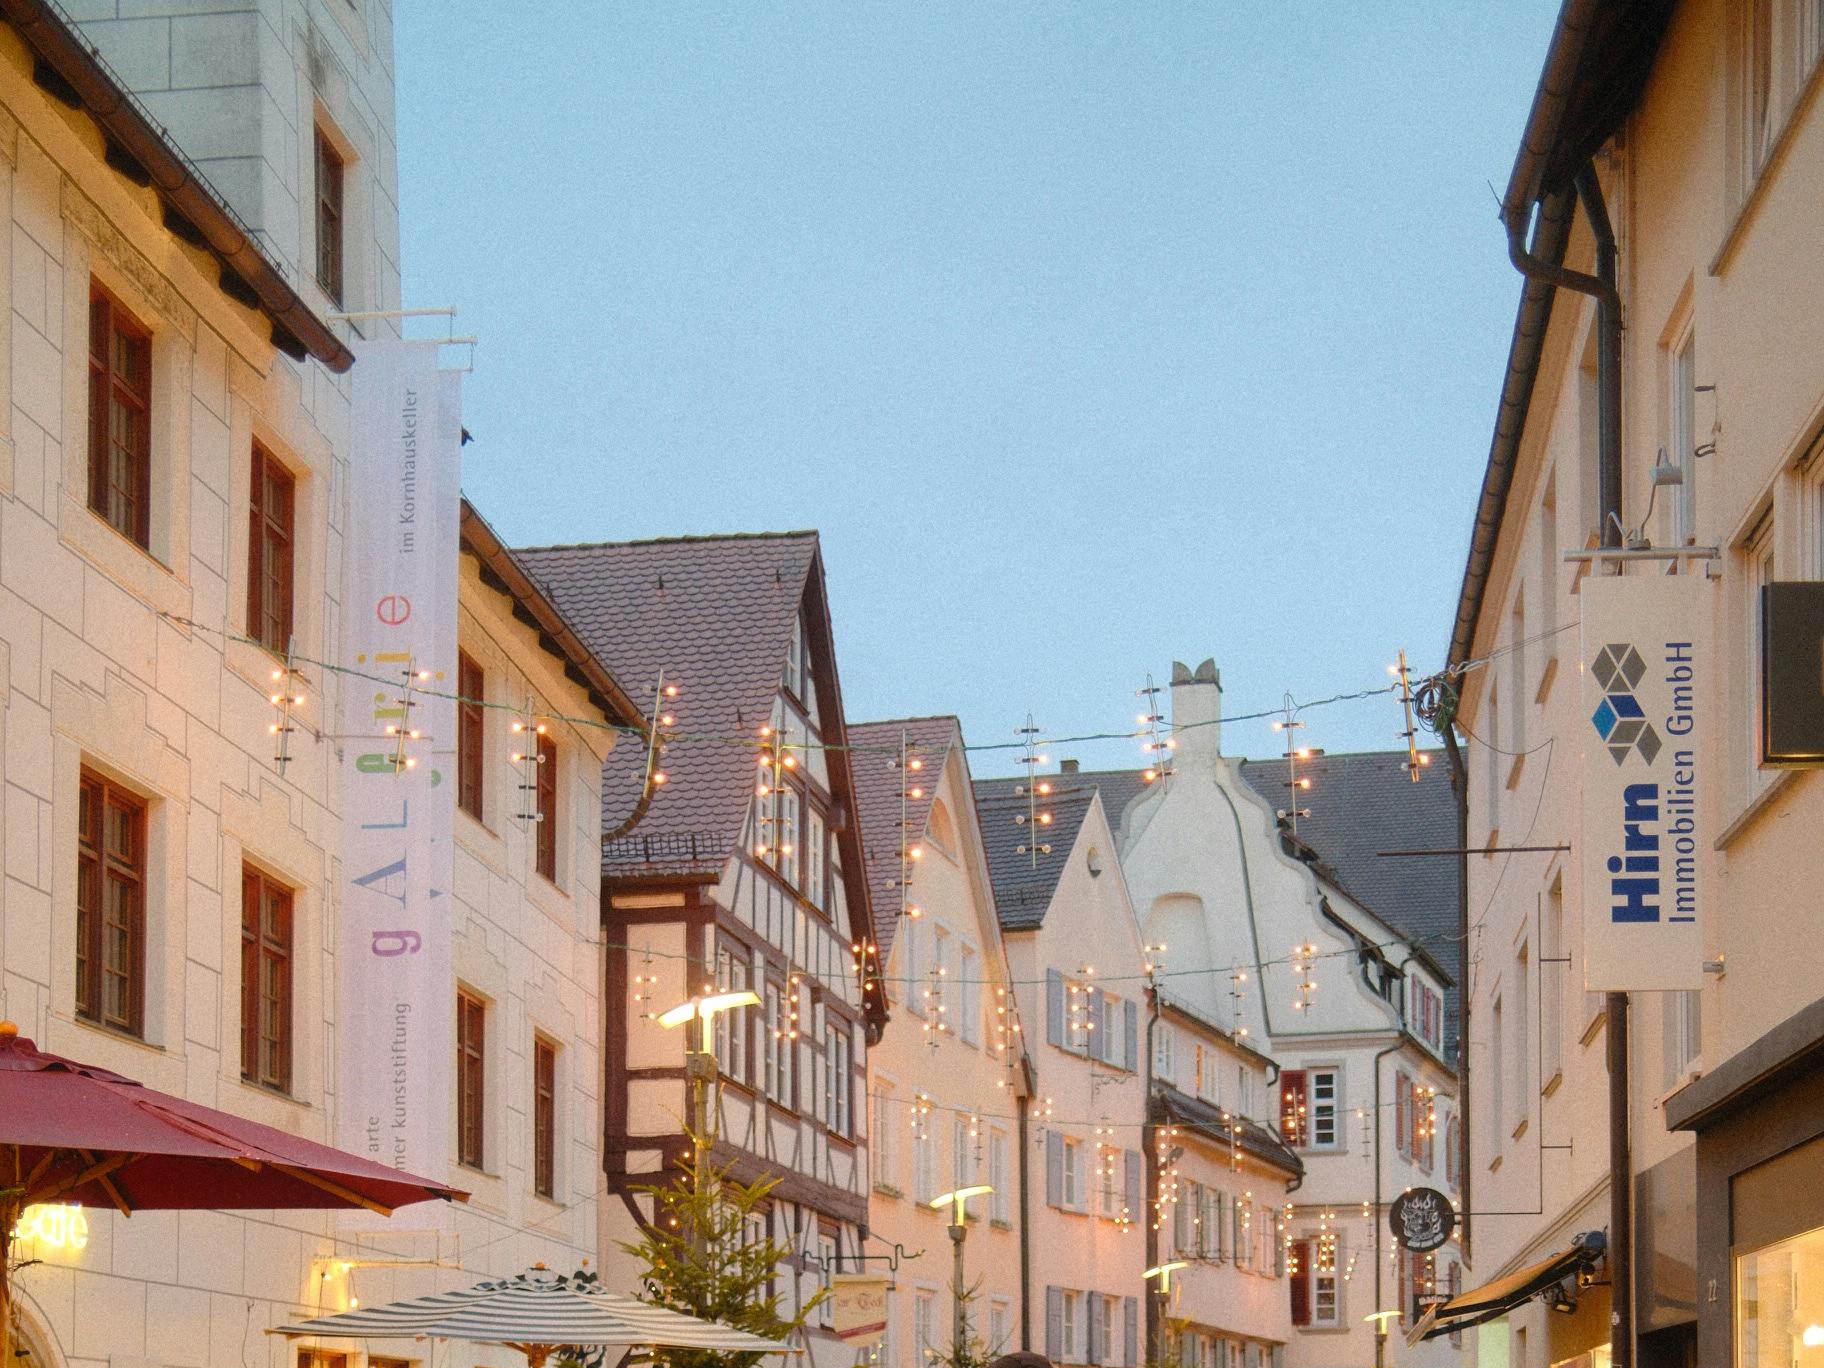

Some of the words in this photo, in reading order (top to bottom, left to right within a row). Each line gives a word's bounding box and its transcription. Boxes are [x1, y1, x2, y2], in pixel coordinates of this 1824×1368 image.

[401, 388, 417, 526] Kornhauskeller
[399, 532, 414, 553] im
[1665, 641, 1693, 736] GmbH
[1606, 783, 1660, 923] Hirn
[1667, 749, 1696, 922] Immobilien
[392, 1003, 411, 1128] kunststiftung
[366, 1116, 380, 1152] arte
[394, 1136, 407, 1170] mer
